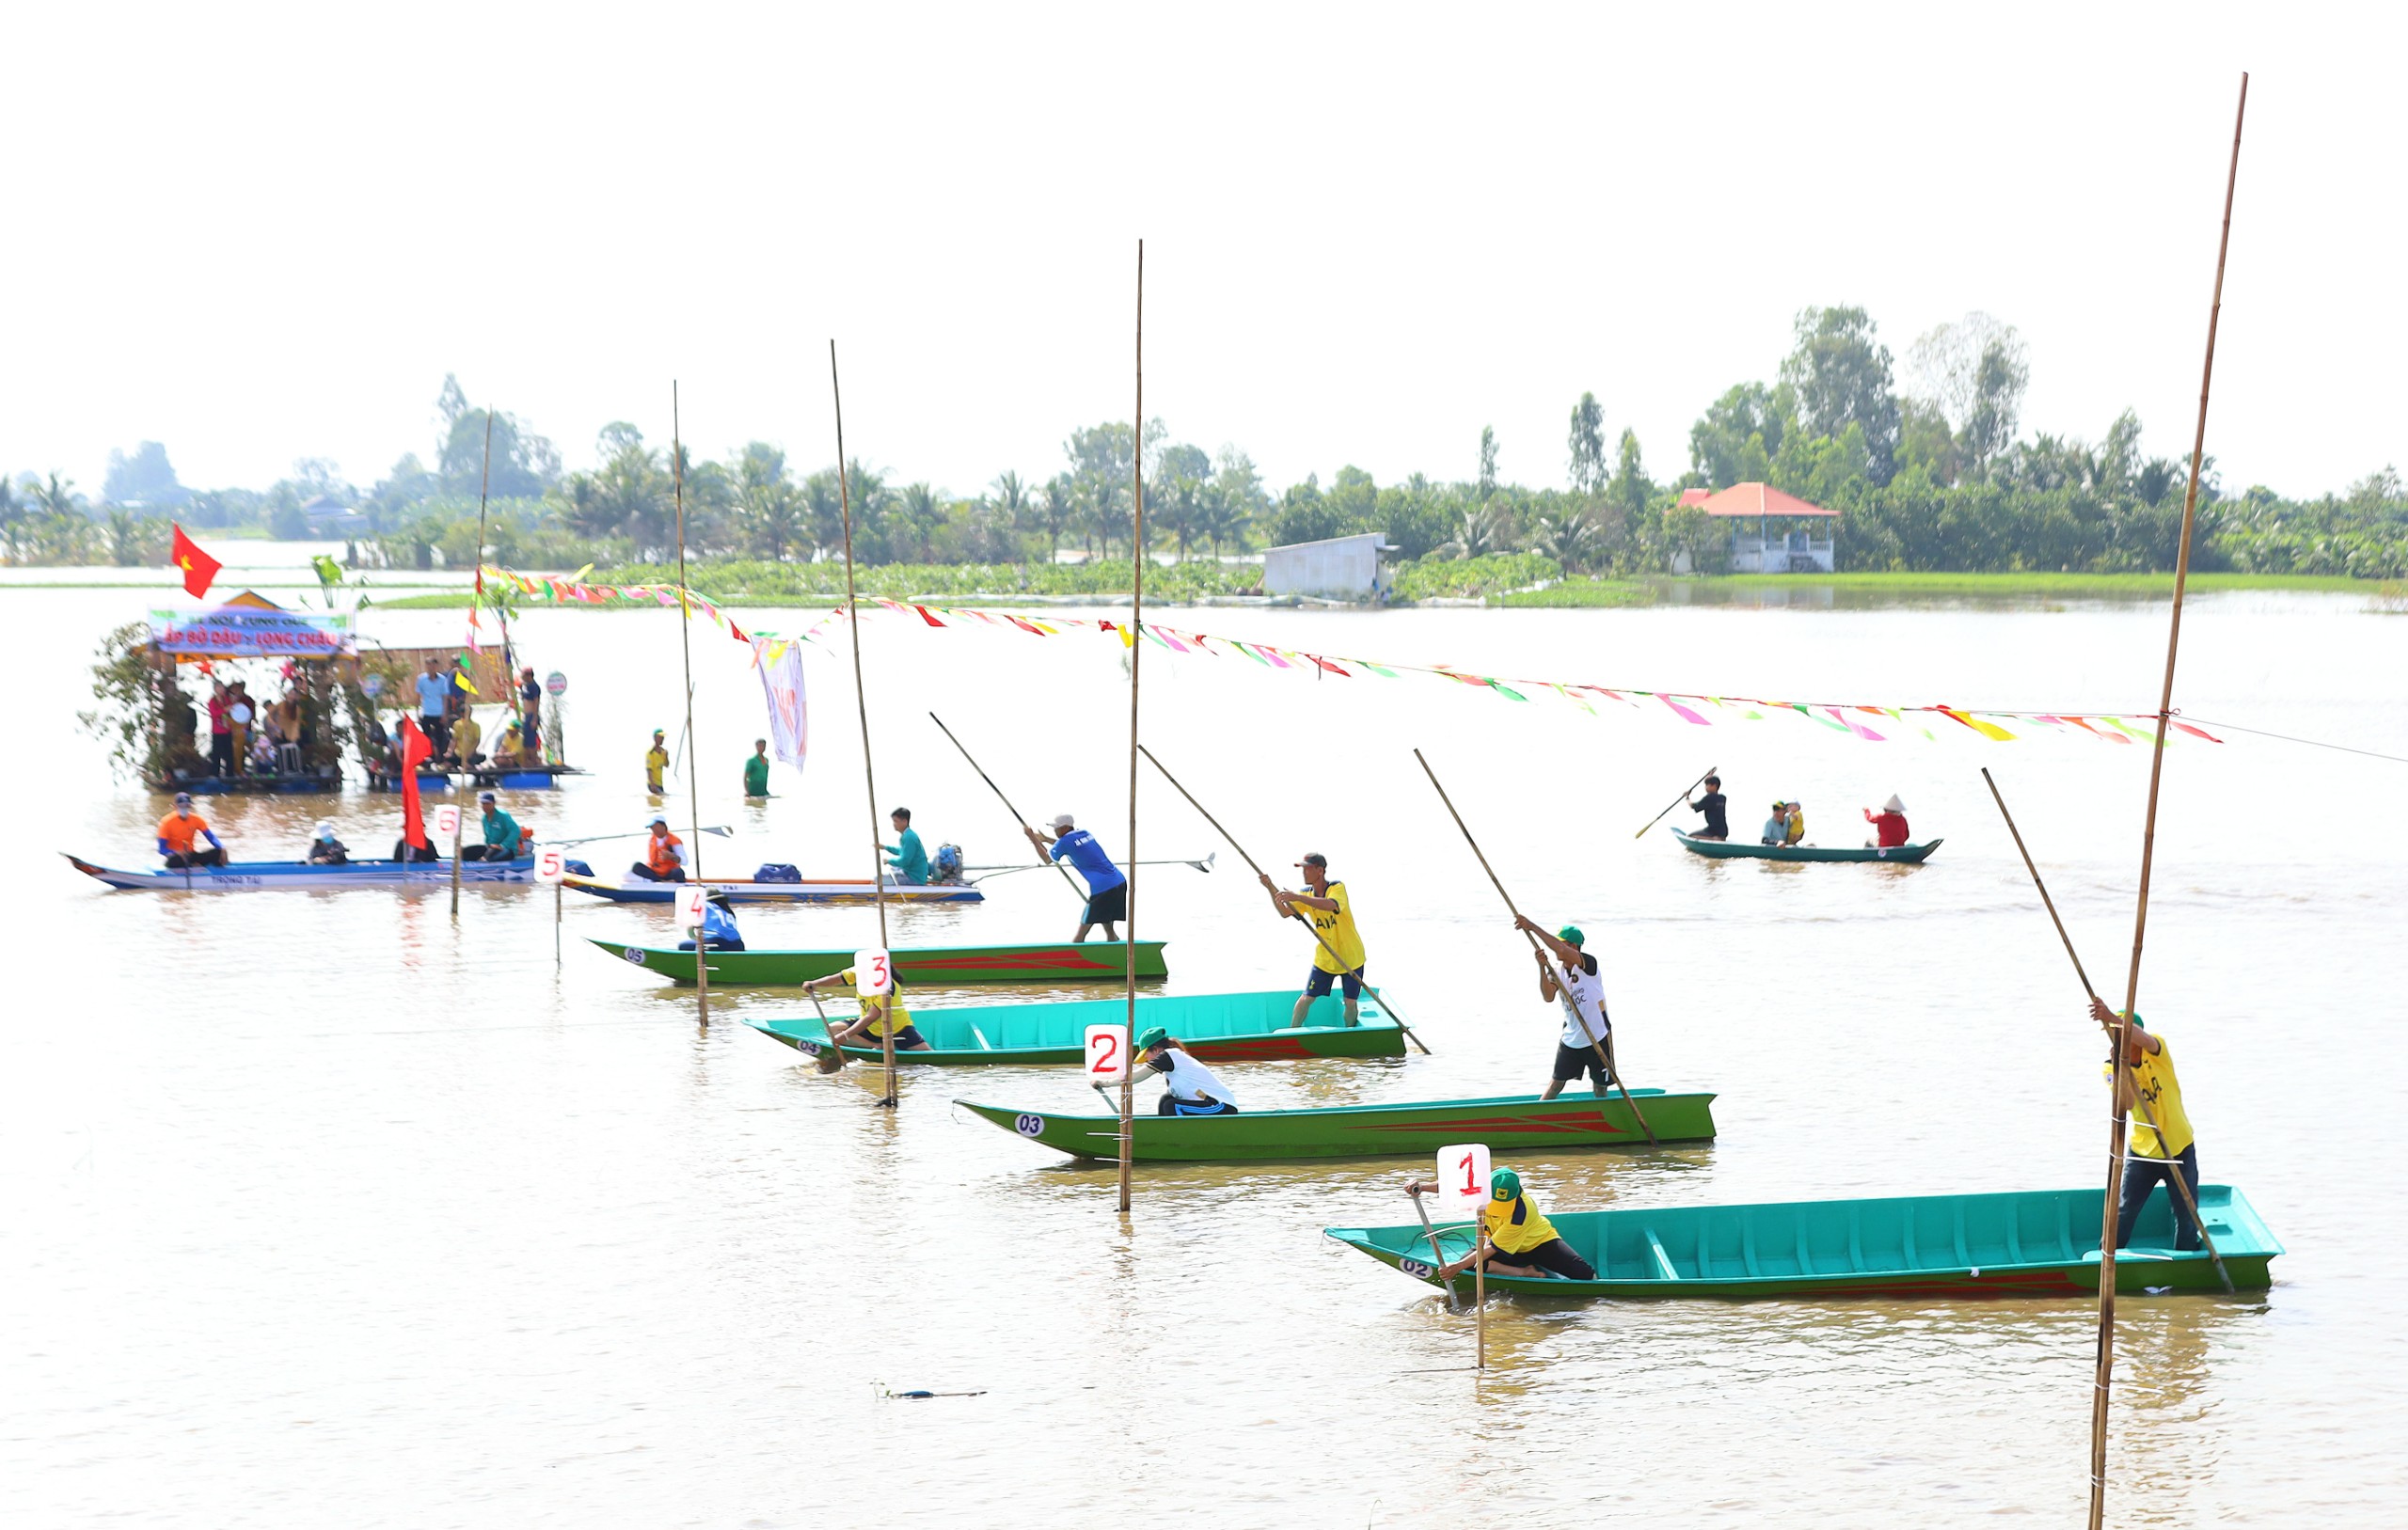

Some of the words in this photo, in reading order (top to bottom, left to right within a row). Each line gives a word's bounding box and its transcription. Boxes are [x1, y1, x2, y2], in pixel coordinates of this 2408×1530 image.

[255, 631, 294, 646] LONG
[438, 810, 456, 831] 6
[541, 853, 560, 876] 5
[690, 892, 703, 918] 4
[626, 948, 643, 962] 05
[872, 954, 888, 987] 3
[800, 1040, 818, 1054] 04
[1091, 1033, 1118, 1073] 2
[1019, 1114, 1041, 1135] 03
[1458, 1150, 1482, 1197] 1
[1402, 1259, 1429, 1277] 02
